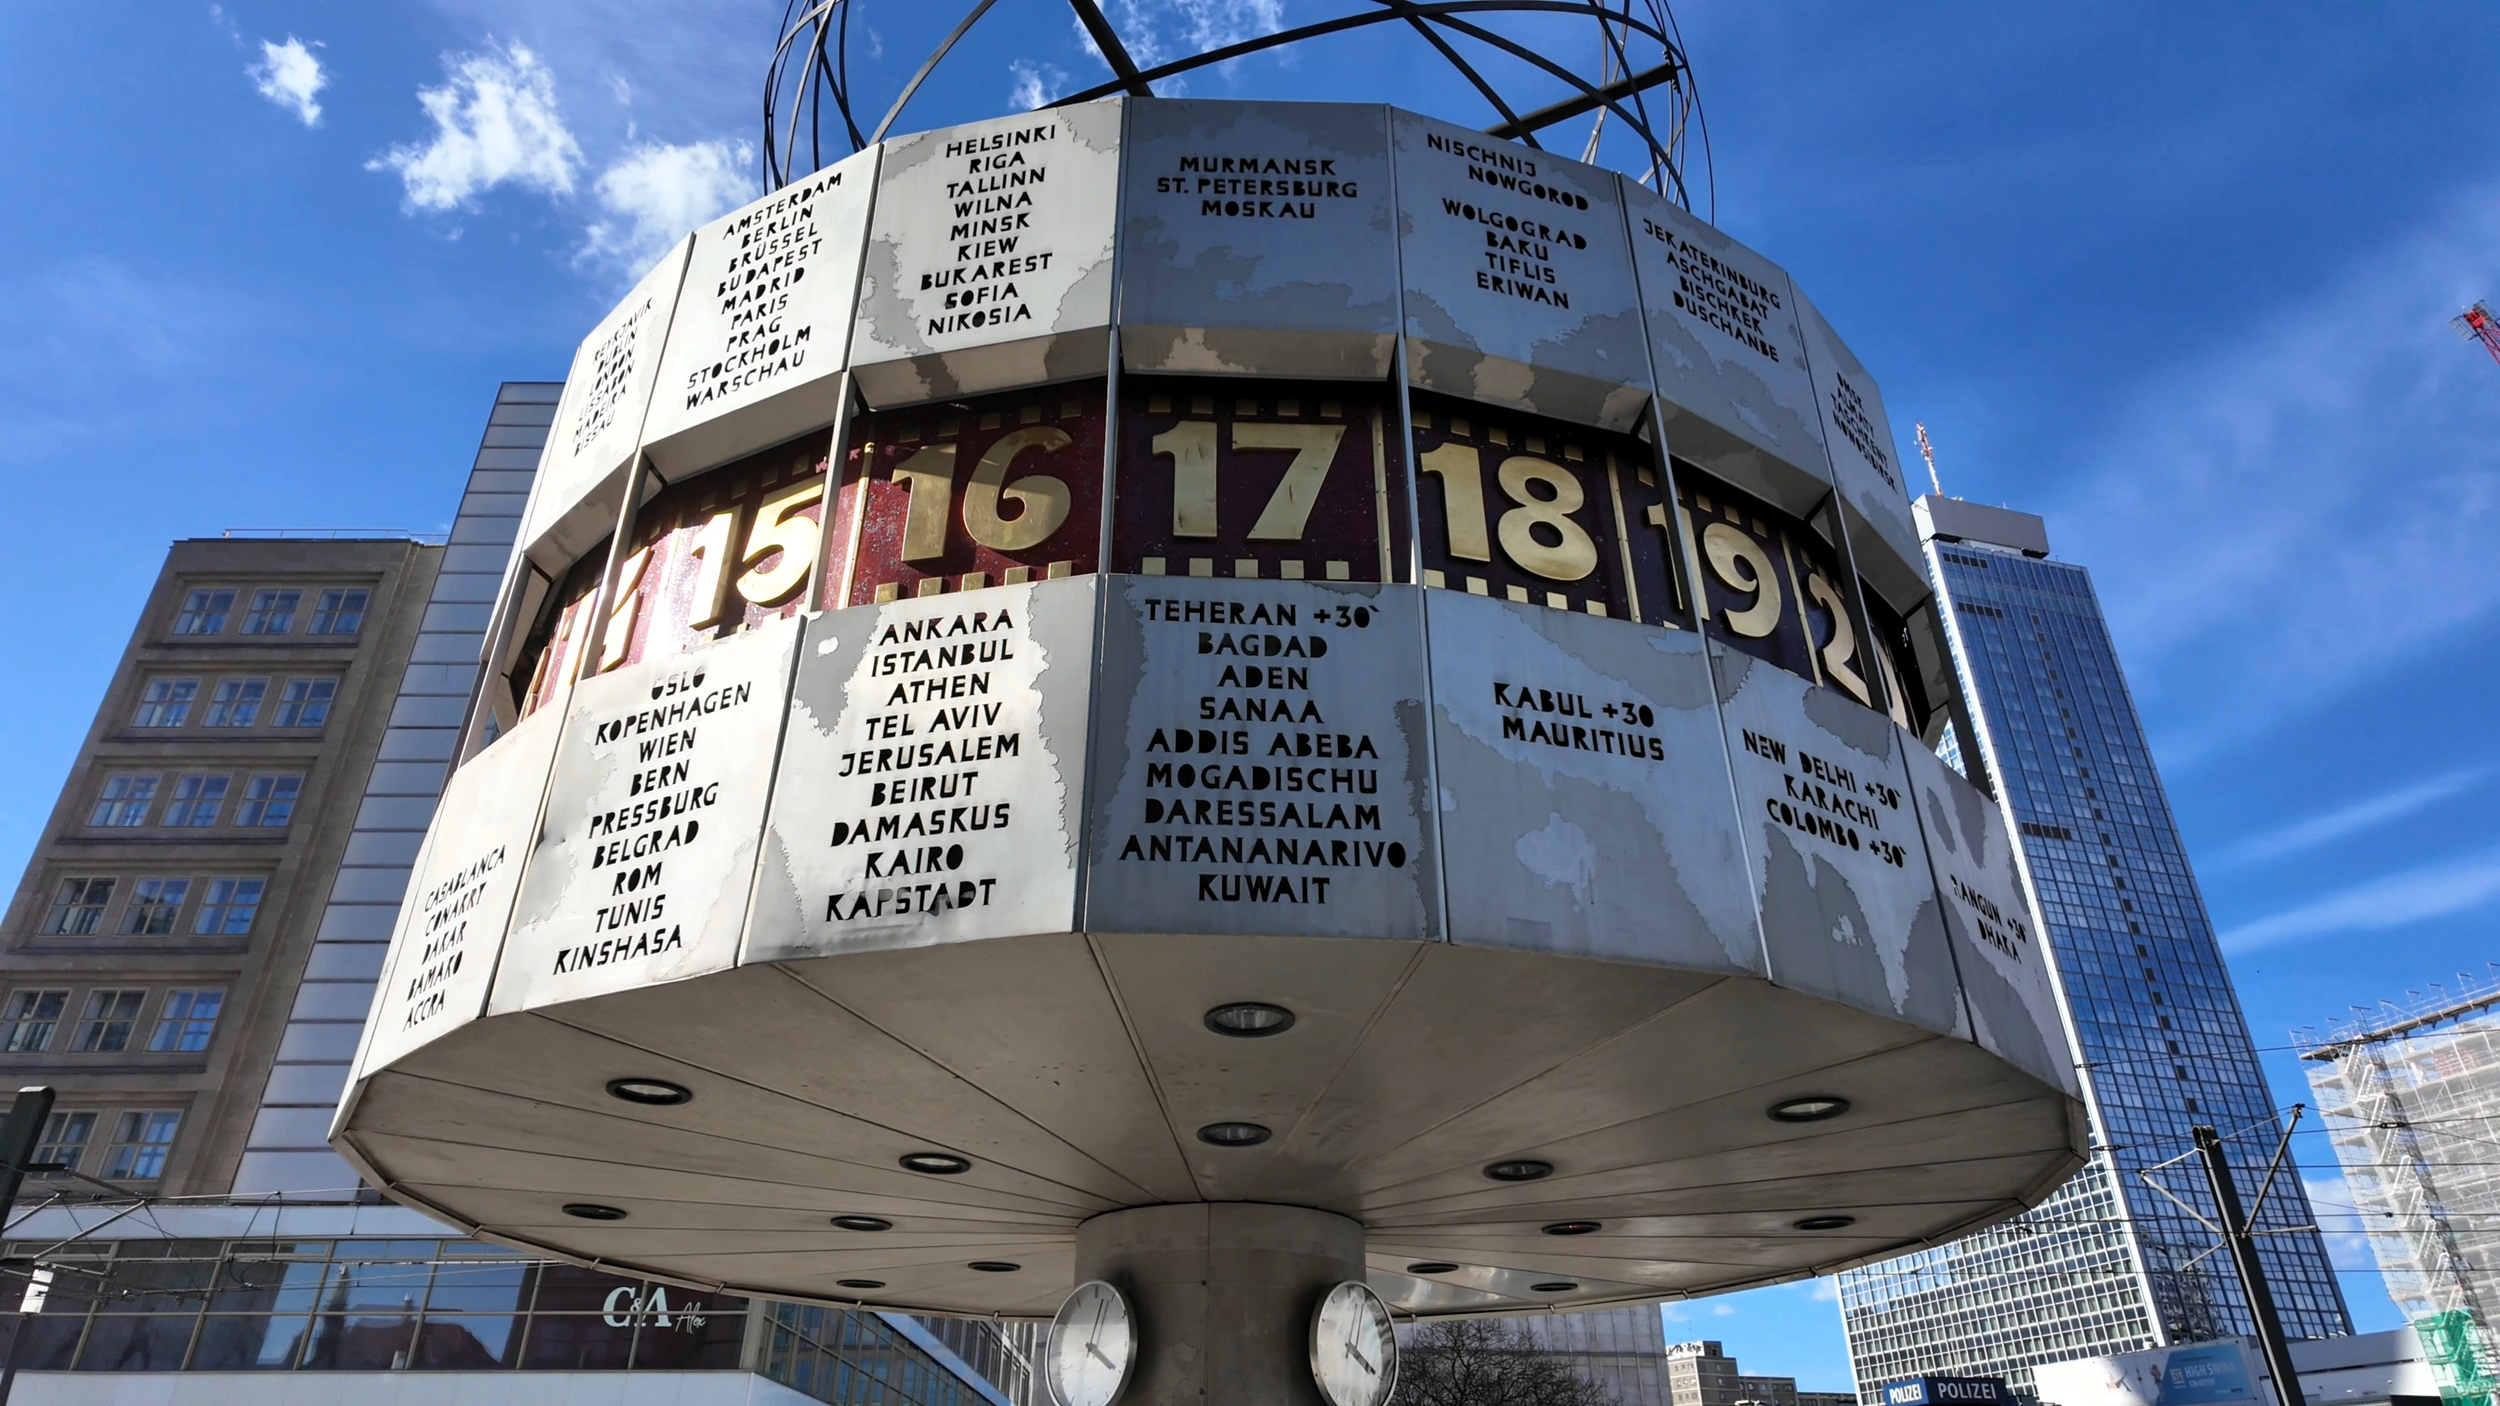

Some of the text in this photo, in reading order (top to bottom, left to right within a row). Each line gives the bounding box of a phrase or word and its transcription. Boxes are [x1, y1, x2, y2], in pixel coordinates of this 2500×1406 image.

[946, 125, 1056, 158] HELSINKI
[969, 151, 1026, 174] RIGA
[1427, 133, 1537, 177] NISCHNIJ
[947, 167, 1046, 199] TALLINN
[1157, 178, 1358, 198] ST. PETERSBURG
[1179, 157, 1337, 176] MURMANSK
[1468, 165, 1589, 211] NOWGOROD
[723, 172, 842, 240] AMSTERDAM
[741, 204, 813, 249] BERLIN
[950, 212, 1031, 241] MINSK
[954, 192, 1034, 218] WILNA
[1201, 201, 1315, 219] MOSKAU
[1442, 198, 1587, 250] WOLGOGRAD
[717, 239, 822, 297] BUDAPEST
[728, 222, 818, 274] BRÜSSEL
[957, 236, 1019, 262] KIEW
[1485, 252, 1556, 284] TIFLIS
[1486, 231, 1548, 261] BAKU
[1643, 218, 1781, 310] JEKATERINBURG
[721, 267, 805, 314] MADRID
[921, 253, 1053, 291] BUKAREST
[1477, 271, 1570, 309] ERIWAN
[1667, 252, 1768, 320] ASCHGABAT
[731, 293, 788, 330] PARIS
[945, 283, 1019, 310] SOFIA
[1679, 276, 1764, 336] BISCHKEK
[594, 297, 652, 364] REYKJAVIK
[727, 316, 783, 352] PRAG
[928, 303, 1032, 336] NIKOSIA
[1673, 291, 1779, 363] DUSCHANBE
[589, 344, 636, 396] LONDON
[597, 326, 638, 374] DUBLIN
[687, 326, 811, 389] STOCKHOLM
[578, 360, 636, 422] LISSABON
[686, 350, 805, 410] WARSCHAU
[573, 384, 627, 443] MADEIRA
[574, 409, 616, 457] BISSAU
[891, 426, 1073, 563] 16
[1151, 420, 1347, 542] 17
[1421, 442, 1598, 581] 18
[688, 484, 824, 630] 15
[1647, 502, 1782, 638] 19
[878, 608, 1014, 647] ANKARA
[1145, 599, 1297, 626] TEHERAN
[871, 638, 1014, 677] ISTANBUL
[1198, 632, 1328, 658] BAGDAD
[651, 666, 706, 700] OSLO
[886, 671, 991, 707] ATHEN
[1217, 665, 1309, 690] ADEN
[595, 681, 752, 746] KOPENHAGEN
[866, 701, 1003, 741] TEL AVIV
[1199, 696, 1324, 724] SANAA
[1493, 682, 1655, 728] KABUL +30
[638, 727, 697, 764] WIEN
[838, 732, 1020, 777] JERUSALEM
[1145, 728, 1380, 759] ADDIS ABEBA
[1502, 715, 1664, 761] MAURITIUS
[630, 760, 690, 797] BERN
[1146, 763, 1378, 794] MOGADISCHU
[1742, 728, 1786, 765] NEW
[1798, 750, 1857, 794] DELHI
[588, 782, 719, 839] PRESSBURG
[870, 771, 978, 807] BEIRUT
[1784, 773, 1880, 831] KARACHI
[830, 802, 1010, 848] DAMASKUS
[1144, 798, 1381, 830] DARESSALAM
[1766, 798, 1860, 851] COLOMBO
[591, 820, 700, 870] BELGRAD
[864, 843, 964, 879] KAIRO
[1119, 834, 1406, 868] ANTANANARIVO
[424, 844, 506, 913] CASABLANCA
[611, 861, 663, 897] ROM
[825, 878, 997, 922] KAPSTADT
[1198, 873, 1330, 904] KUWAIT
[425, 881, 487, 938] CONAKRY
[595, 894, 666, 933] TUNIS
[421, 921, 468, 966] DAKAR
[552, 924, 682, 975] KINSHASA
[1977, 917, 2022, 965] DHAKA
[407, 950, 463, 1002] BAMAKO
[402, 989, 446, 1032] ACCRA
[603, 1286, 707, 1334] C&A Alex
[1938, 1383, 1997, 1399] POLIZEI
[2184, 1364, 2207, 1378] HIGH
[1889, 1384, 1922, 1405] POLIZEI
